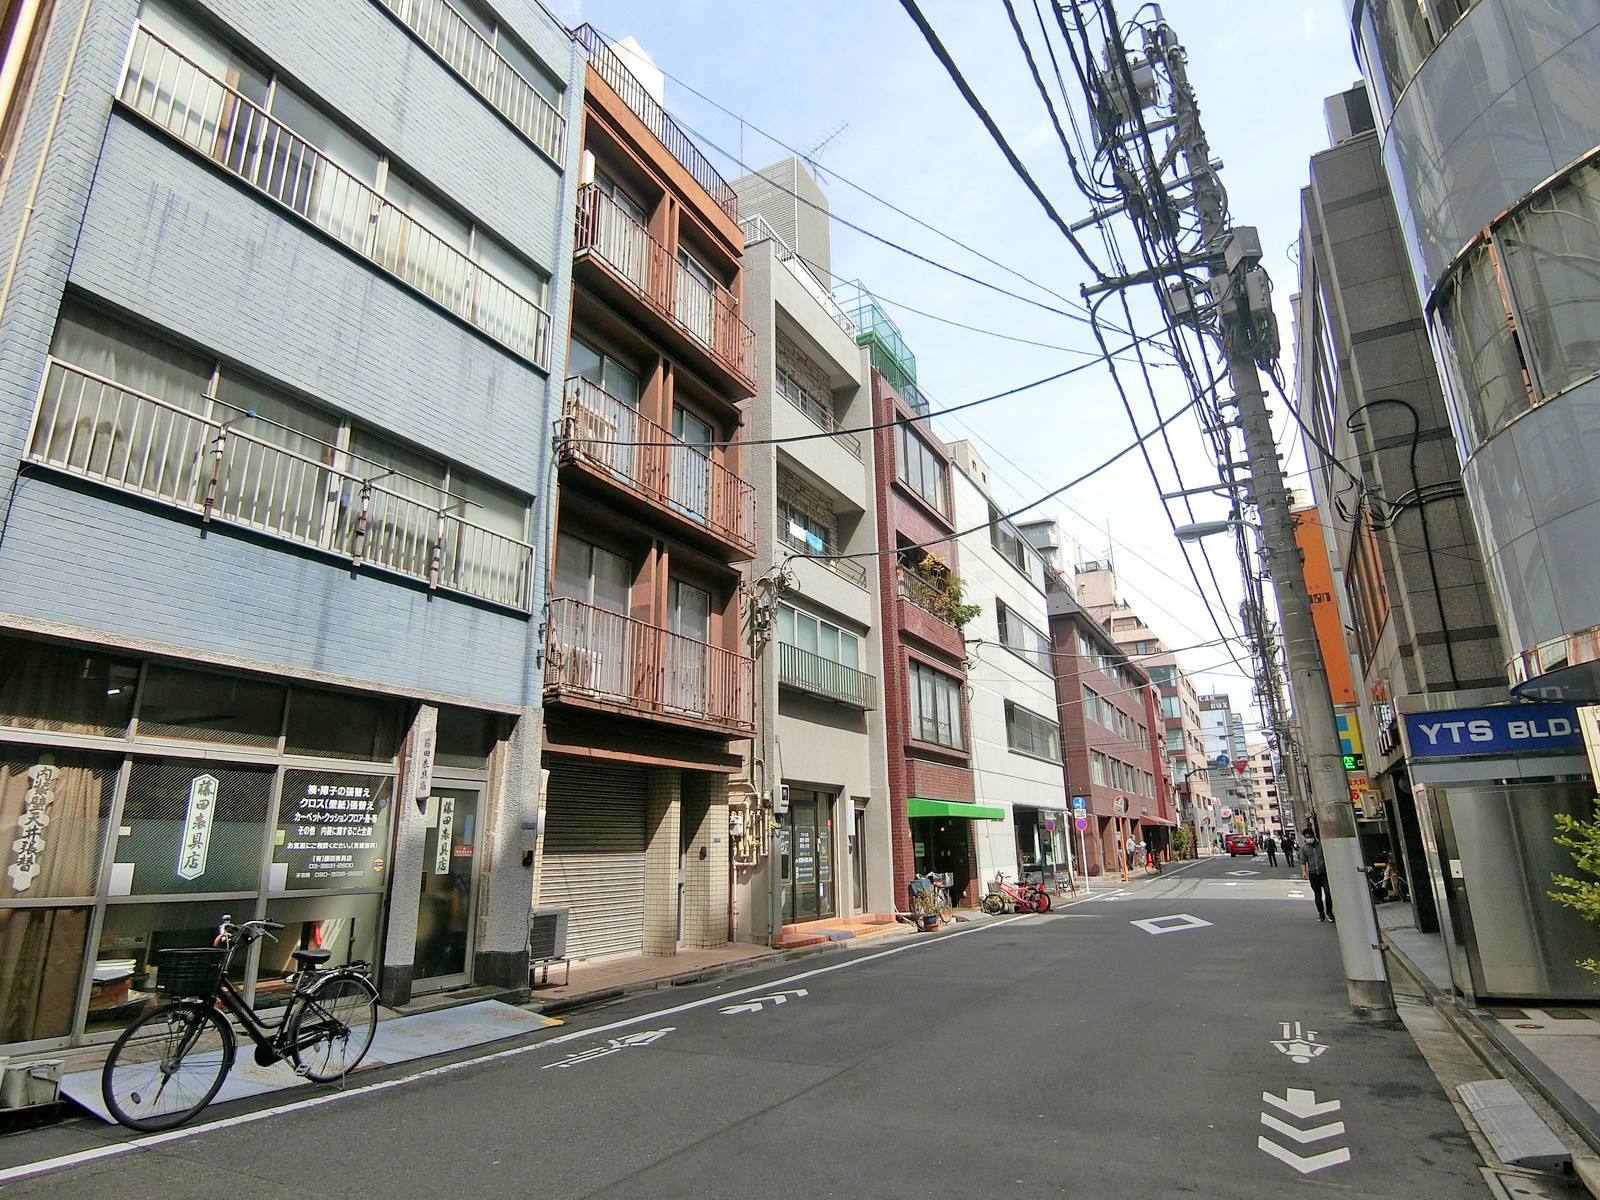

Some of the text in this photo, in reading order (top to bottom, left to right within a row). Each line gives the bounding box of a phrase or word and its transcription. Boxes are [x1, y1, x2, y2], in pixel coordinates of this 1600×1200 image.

[1418, 718, 1579, 744] YTS BLD.
[419, 737, 432, 791] 藤田表具店
[183, 780, 214, 869] 藤田表具店
[298, 825, 316, 836] その他
[437, 801, 454, 872] 藤田表具店
